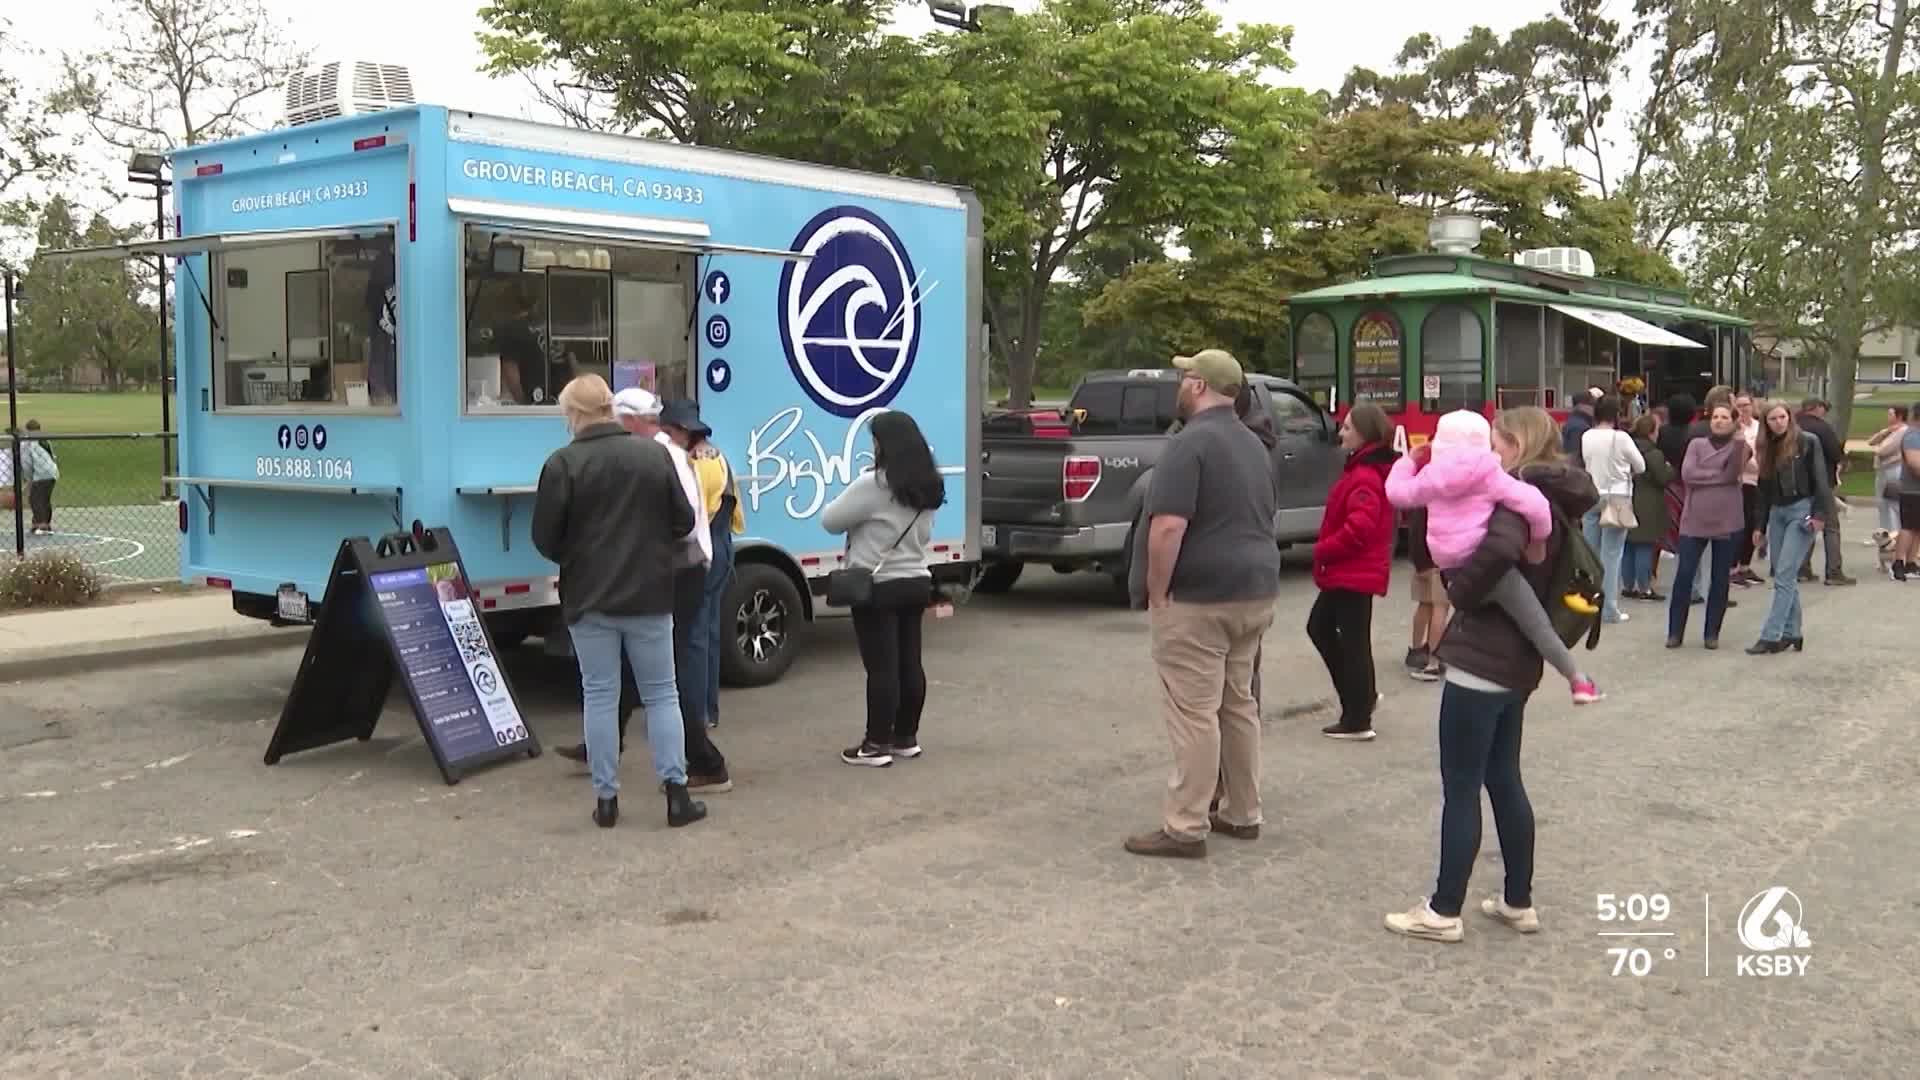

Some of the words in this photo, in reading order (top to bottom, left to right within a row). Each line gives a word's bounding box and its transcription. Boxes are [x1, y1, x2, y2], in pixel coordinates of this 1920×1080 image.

[231, 195, 273, 213] GROVER
[275, 189, 313, 207] BEACH,
[315, 186, 331, 201] CA
[333, 180, 368, 199] 93433
[463, 159, 547, 185] GROVER
[551, 168, 619, 195] BEACH,
[622, 177, 648, 198] CA
[652, 183, 704, 204] 93433
[256, 457, 353, 480] 805.888.1064
